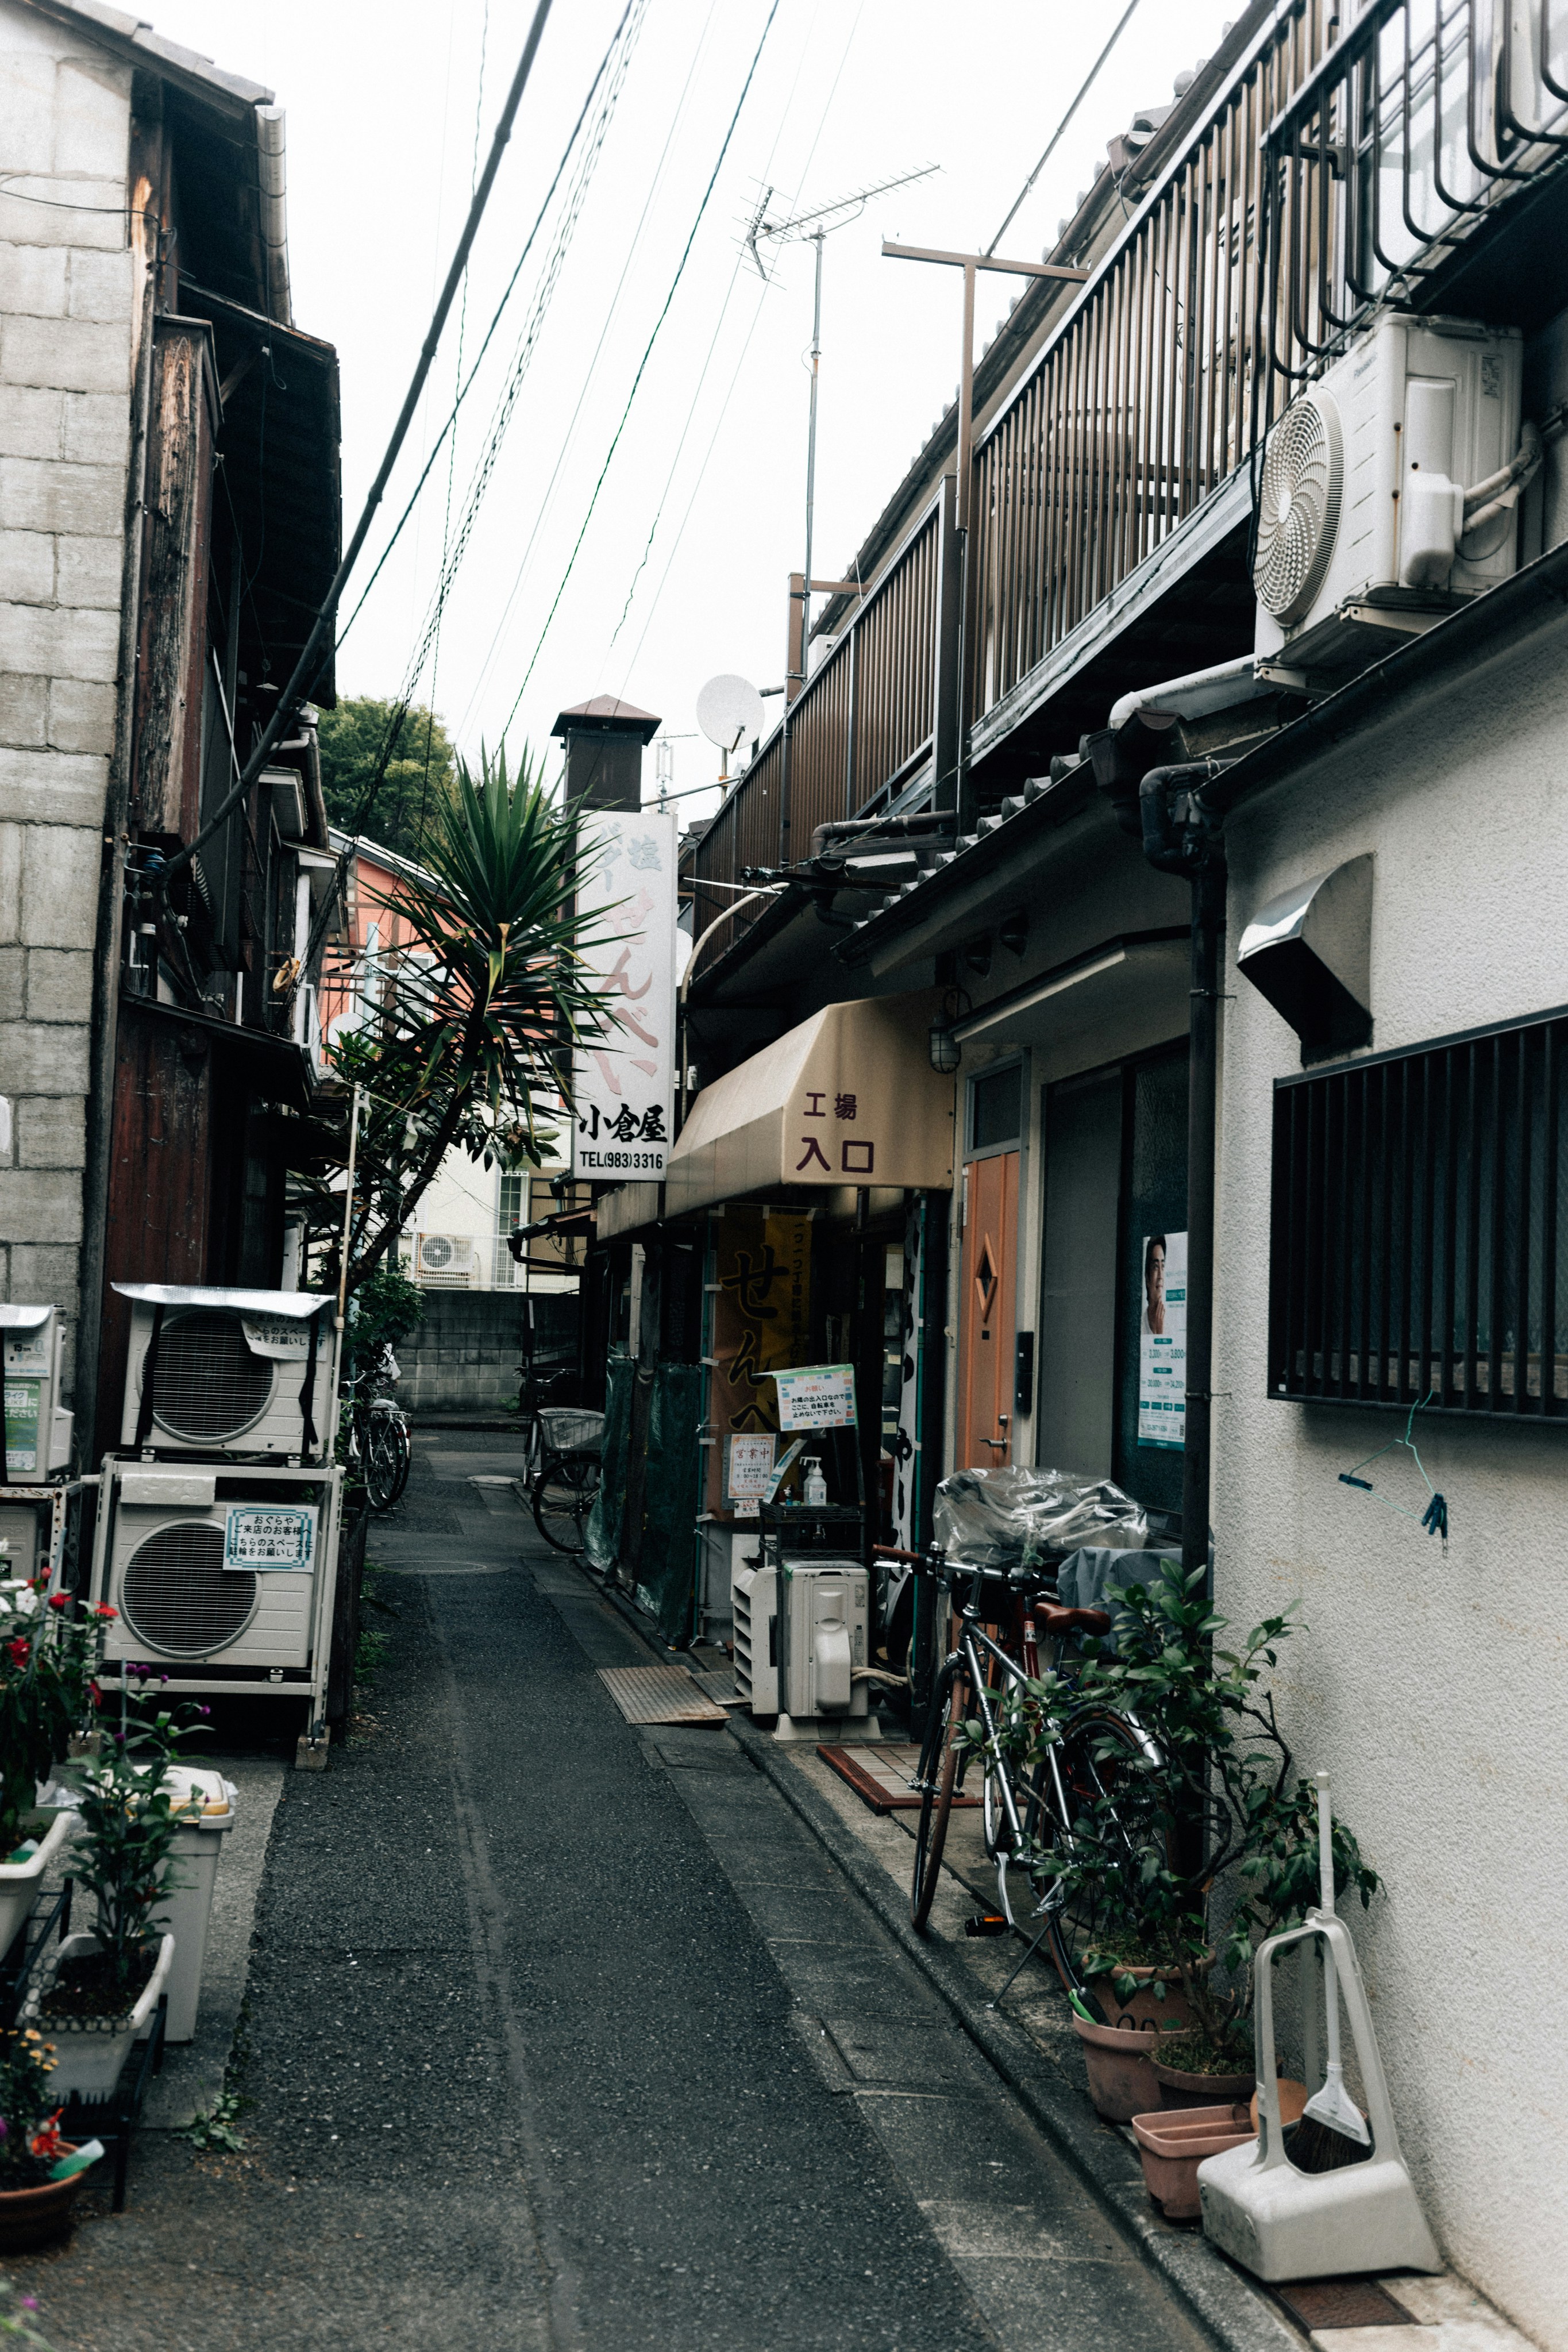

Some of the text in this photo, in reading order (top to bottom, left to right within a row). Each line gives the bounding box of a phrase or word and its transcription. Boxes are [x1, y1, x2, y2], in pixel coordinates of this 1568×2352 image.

[627, 834, 662, 871] 塩
[592, 886, 658, 1095] せんべい
[803, 1092, 857, 1120] 工場
[579, 1103, 668, 1143] 小倉屋
[580, 1151, 662, 1169] TEL(983)3316
[796, 1137, 874, 1173] 入口
[791, 1394, 845, 1404] お隣の出入口なので
[792, 1402, 835, 1411] ここに、自転車を
[793, 1410, 842, 1419] 止めないで下さい。
[736, 1448, 769, 1460] 営業中
[255, 1515, 294, 1525] おぐらや
[234, 1525, 311, 1535] ご来店のお客様へ
[230, 1538, 313, 1548] こちらのスペースに
[229, 1547, 313, 1557] 駐輪をお願いします
